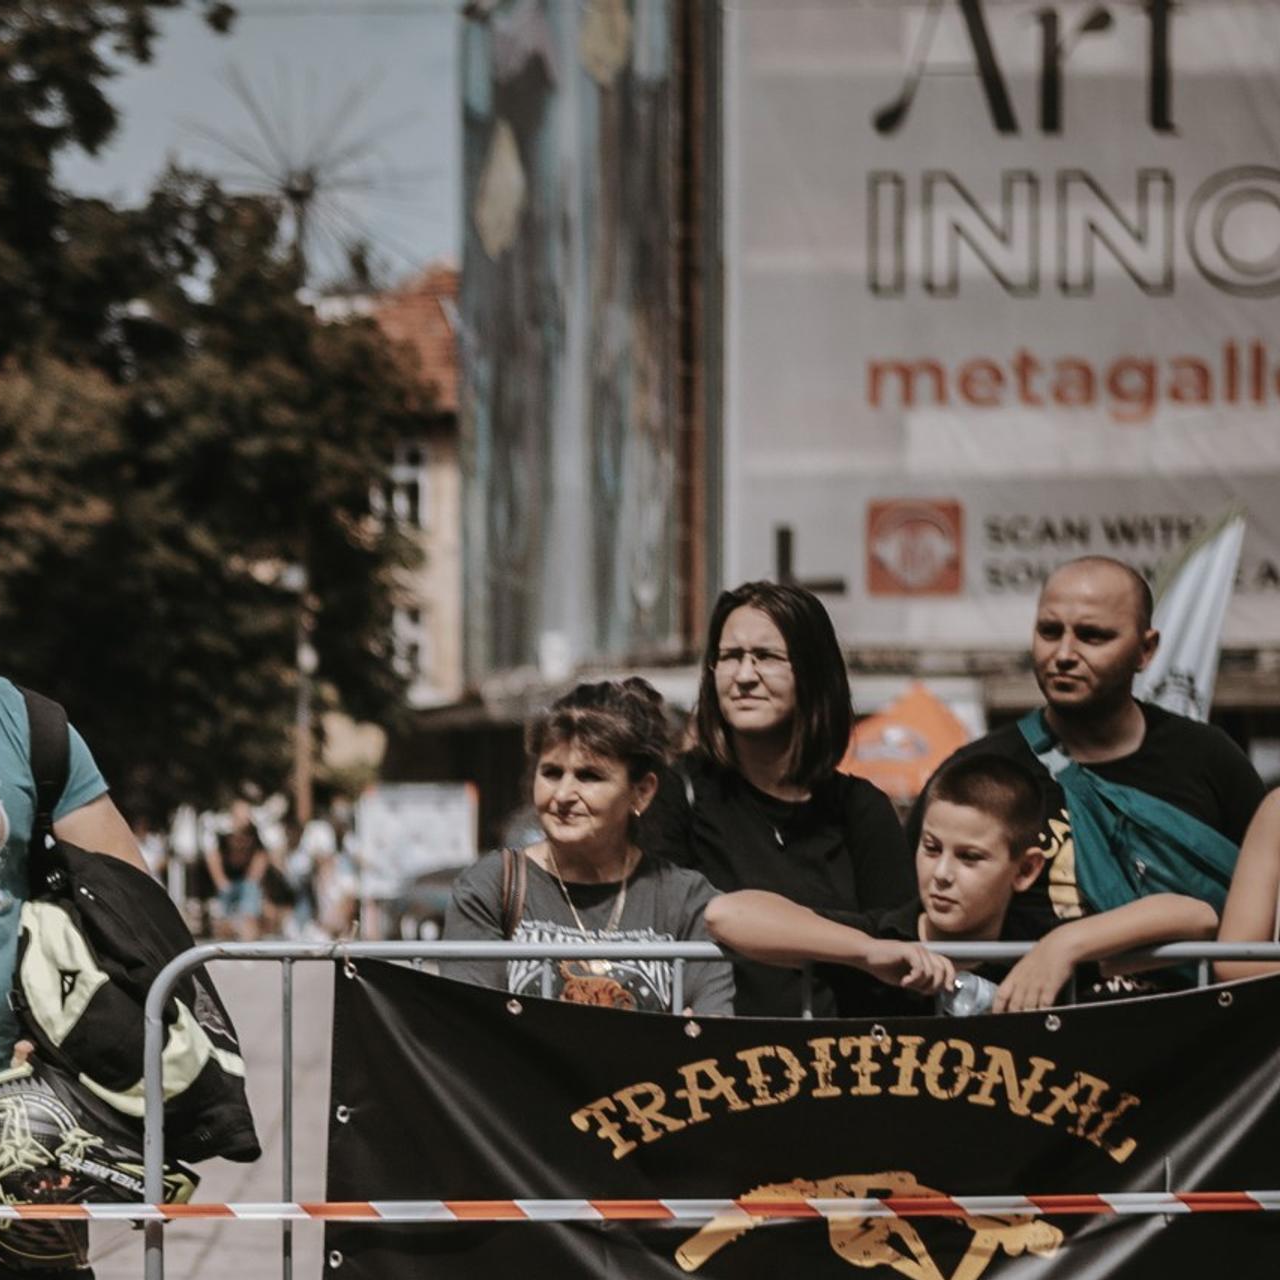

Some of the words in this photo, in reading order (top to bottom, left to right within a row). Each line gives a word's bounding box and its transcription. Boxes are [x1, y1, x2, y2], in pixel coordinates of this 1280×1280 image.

[873, 0, 1182, 137] Art
[867, 164, 1280, 299] INNO
[865, 338, 1280, 423] metagall
[984, 515, 1091, 547] SCAN
[570, 1034, 1140, 1164] TRADITIONAL
